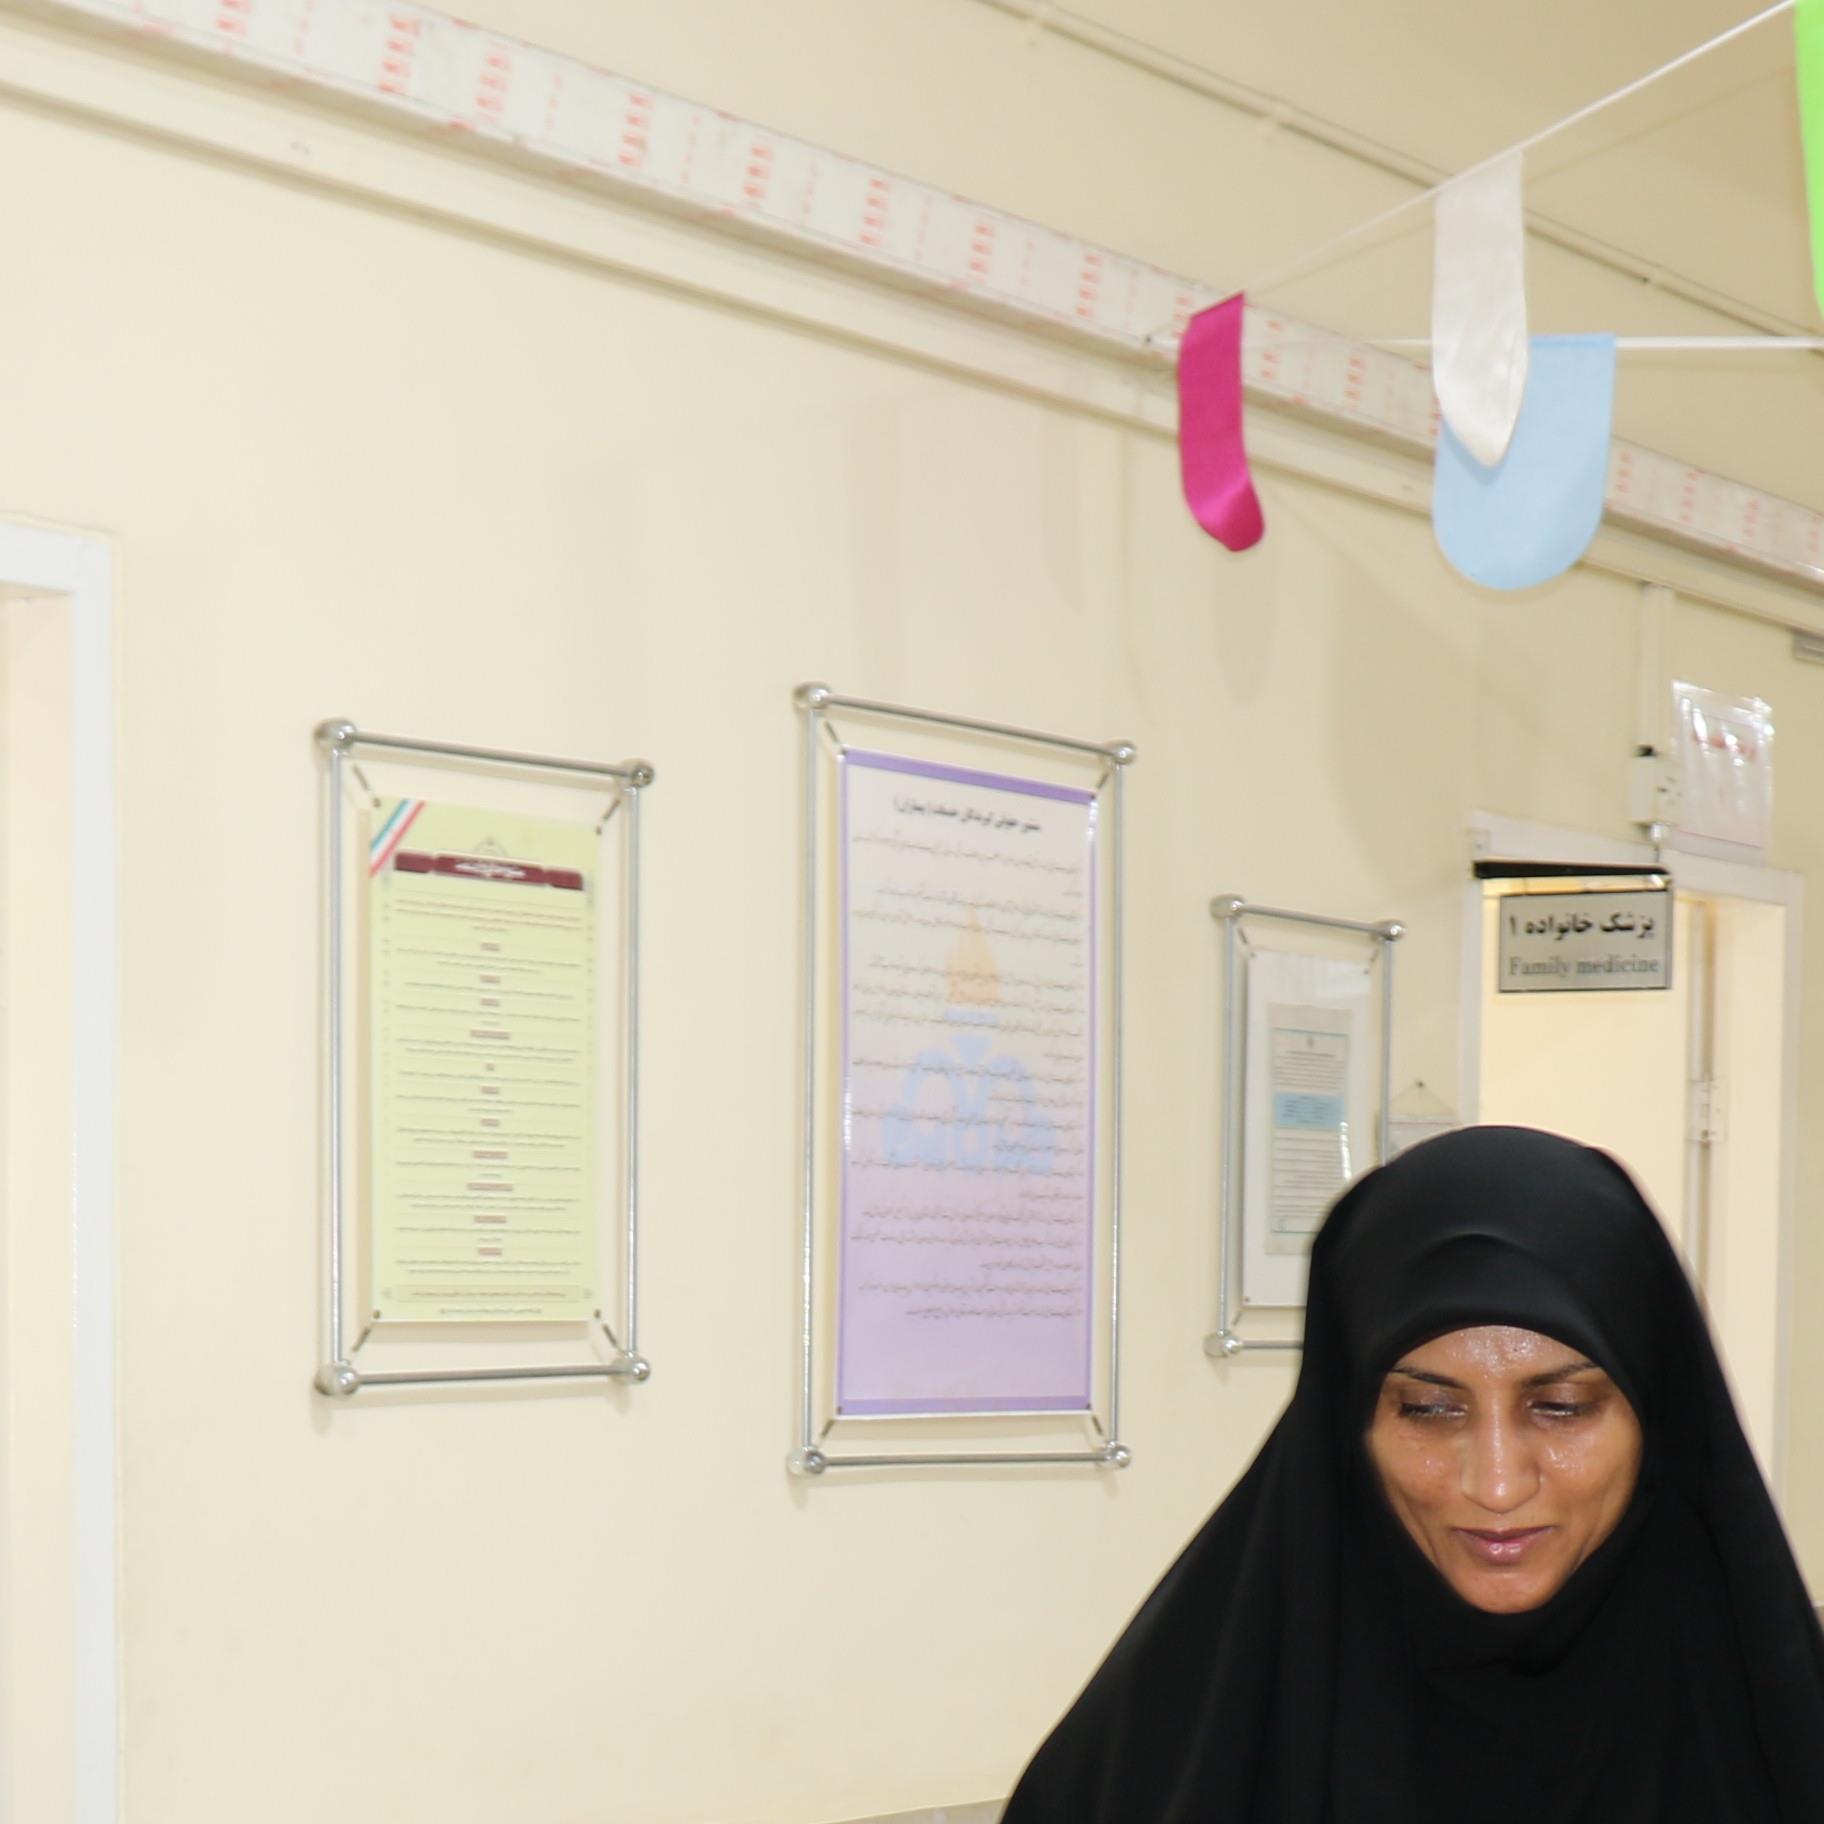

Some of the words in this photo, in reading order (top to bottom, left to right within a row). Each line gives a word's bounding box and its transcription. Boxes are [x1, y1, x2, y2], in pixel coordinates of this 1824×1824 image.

[1525, 912, 1593, 941] خانواده
[1600, 912, 1654, 939] پزشک
[1509, 956, 1569, 978] Family
[1577, 954, 1660, 974] medicine
